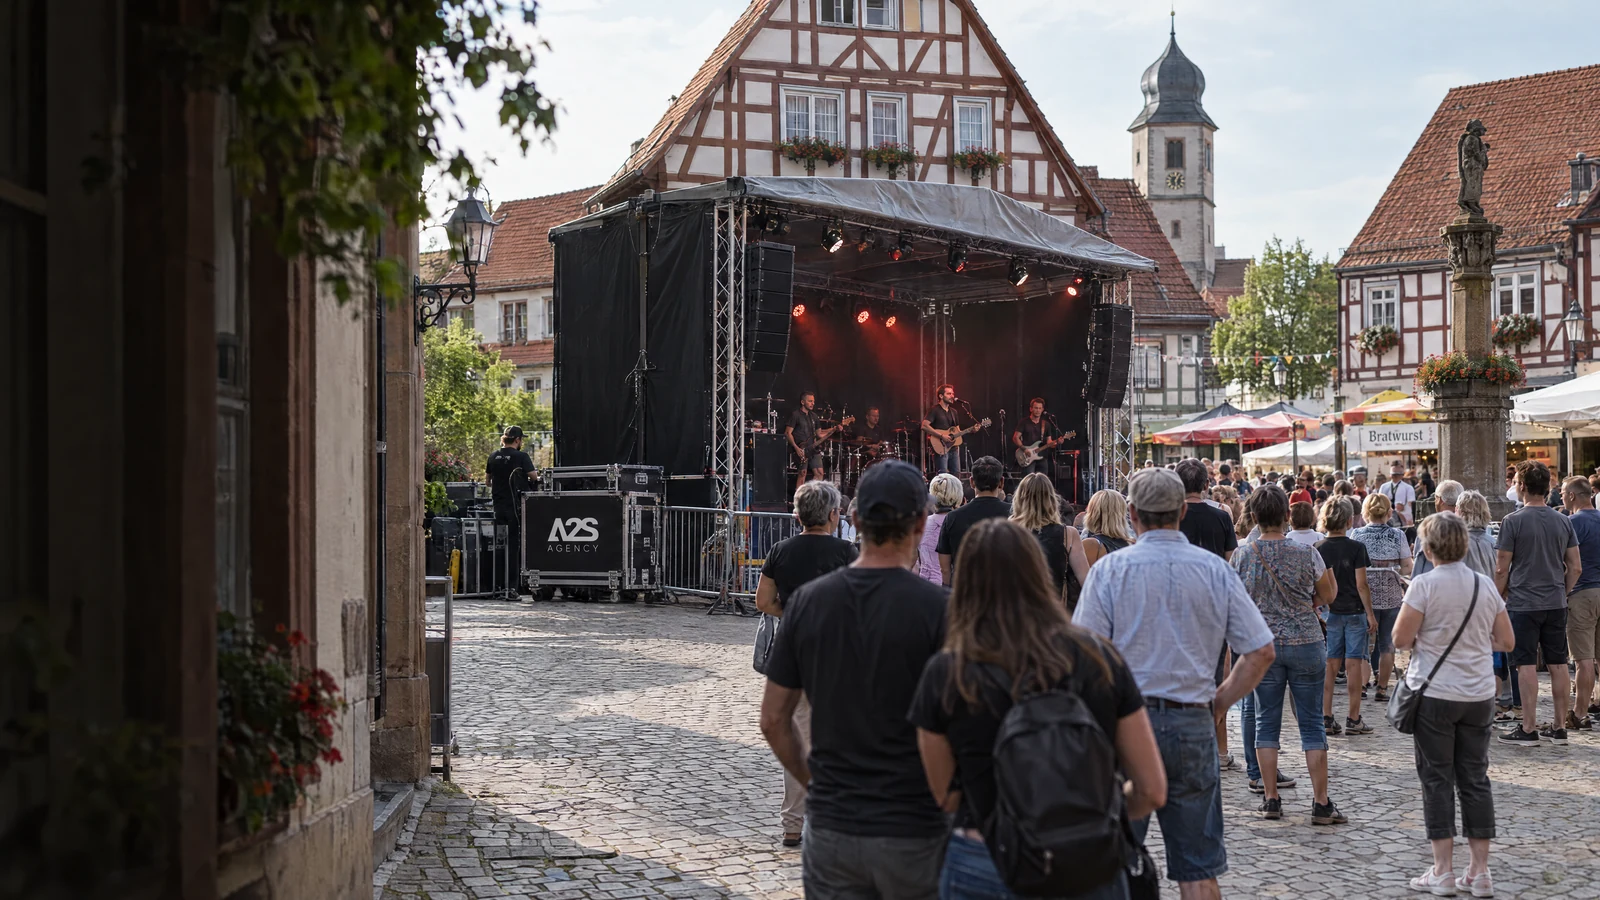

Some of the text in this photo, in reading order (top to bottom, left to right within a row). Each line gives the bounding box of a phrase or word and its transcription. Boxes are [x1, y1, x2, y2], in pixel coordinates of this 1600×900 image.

[1368, 430, 1423, 442] Bratwurst
[547, 517, 599, 542] A2S
[547, 544, 599, 553] AGENCY
